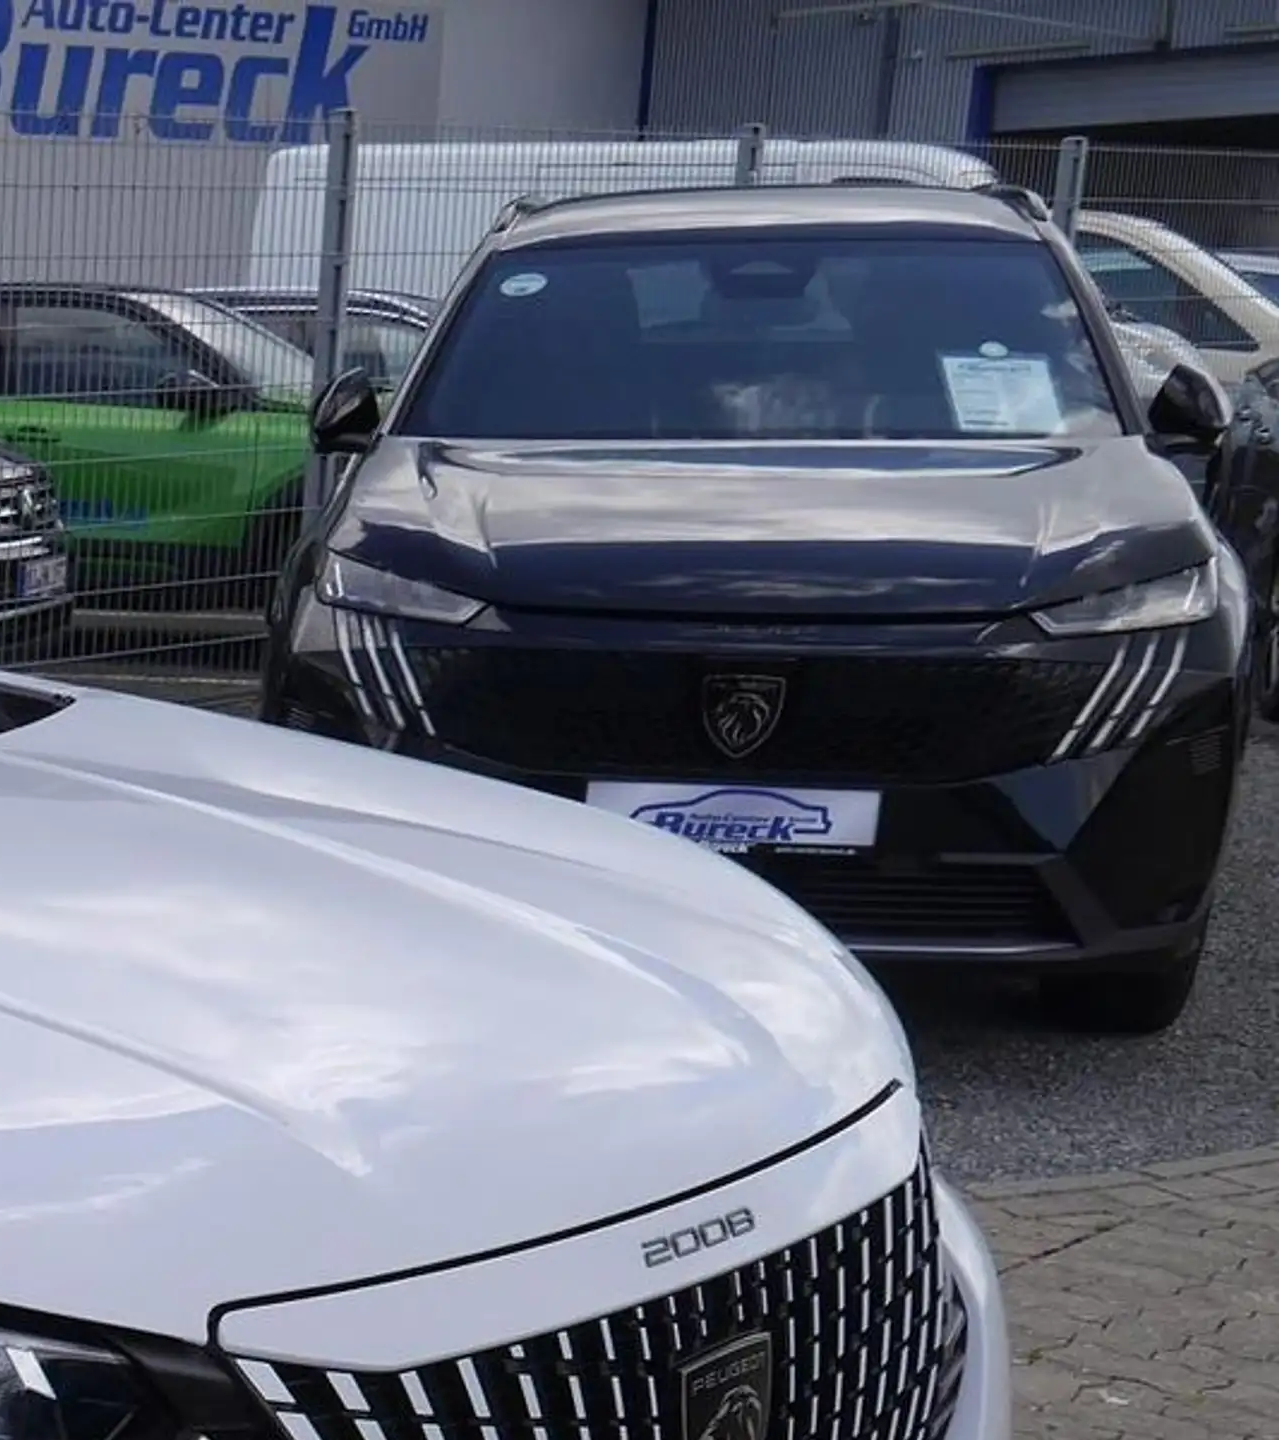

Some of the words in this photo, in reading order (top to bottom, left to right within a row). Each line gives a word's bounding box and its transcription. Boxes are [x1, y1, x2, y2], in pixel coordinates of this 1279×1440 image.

[20, 0, 296, 44] Auto-Center
[346, 9, 429, 43] GmbH
[641, 1207, 755, 1268] 2008
[692, 1350, 766, 1396] PEUGEOT
